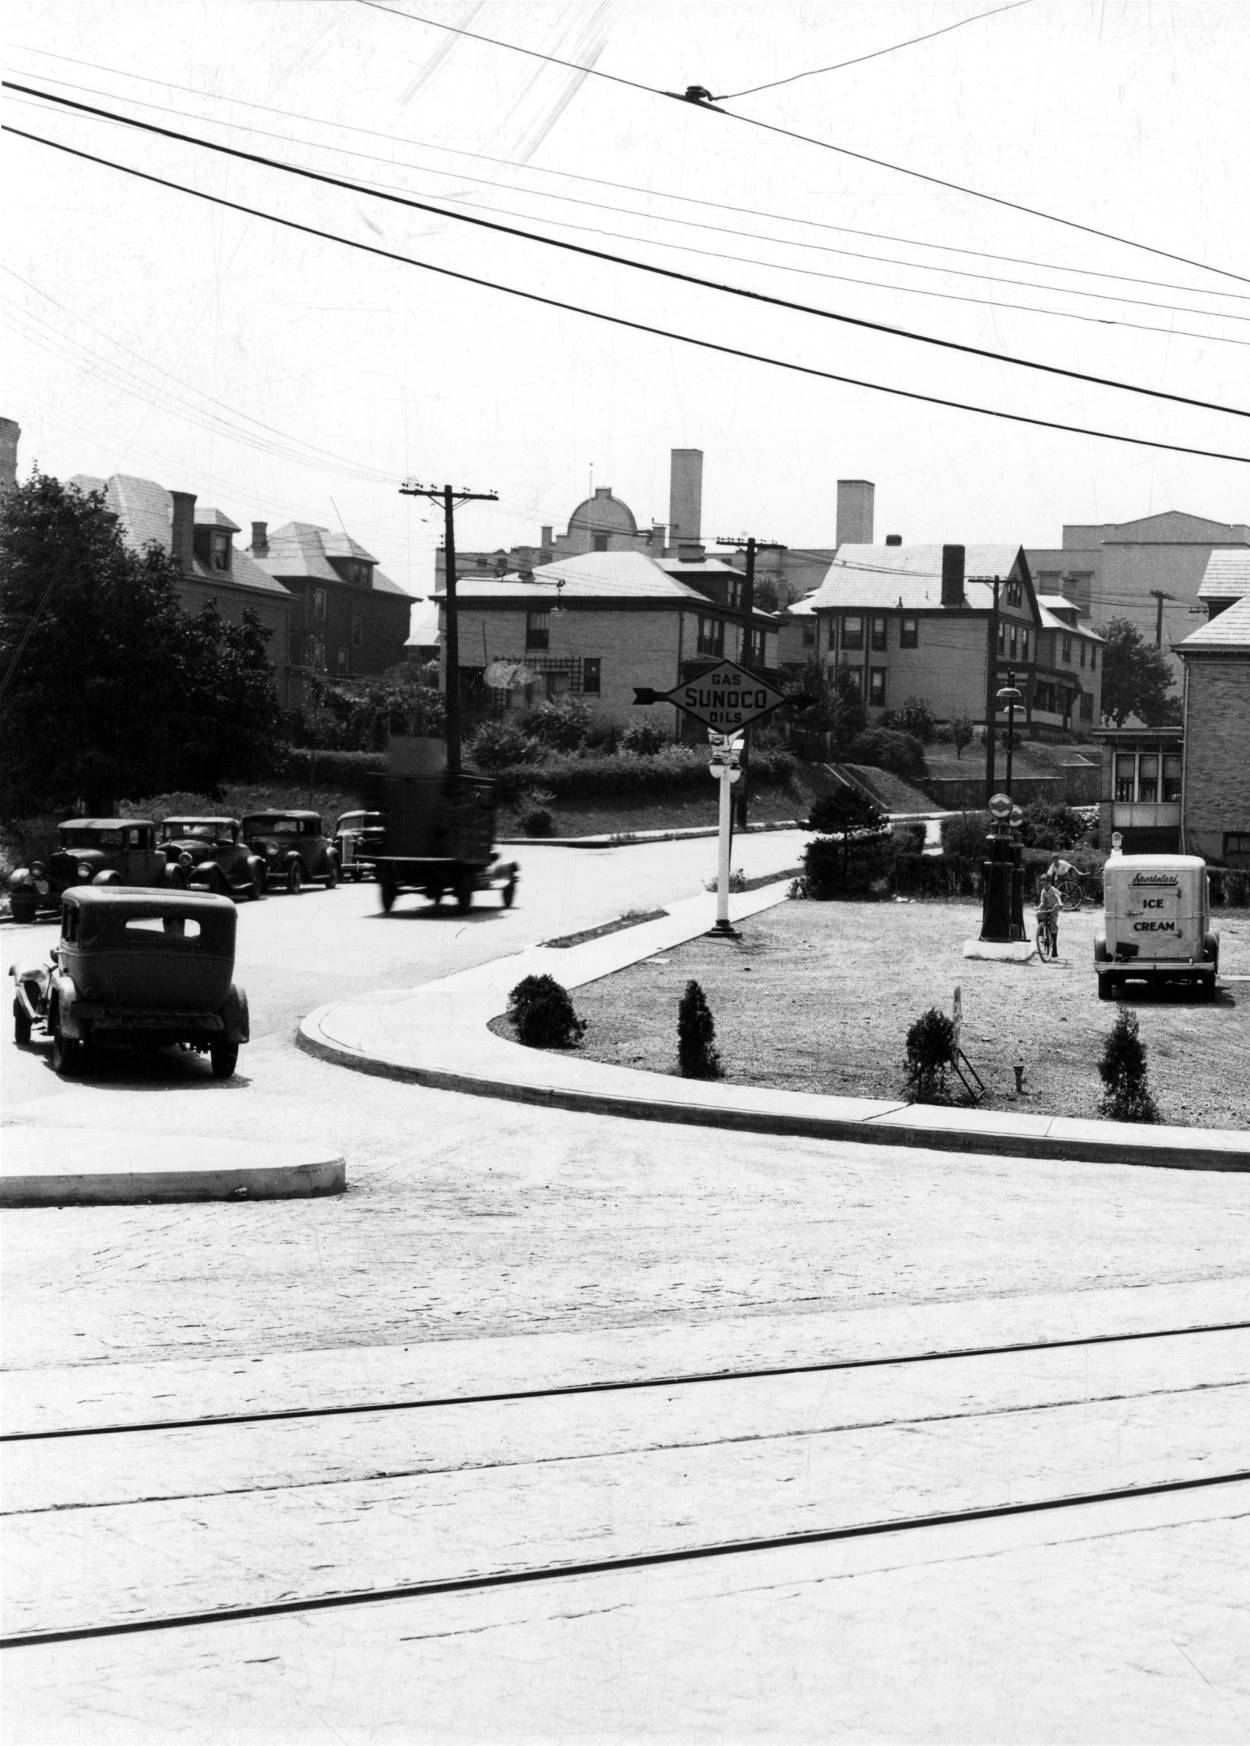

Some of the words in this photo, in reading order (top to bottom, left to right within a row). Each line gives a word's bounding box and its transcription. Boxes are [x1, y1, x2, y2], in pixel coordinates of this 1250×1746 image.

[712, 674, 742, 686] GAS
[685, 687, 767, 709] SUNOCO
[709, 711, 742, 723] OILS
[1143, 899, 1164, 909] ICE
[1133, 922, 1175, 932] CREAM
